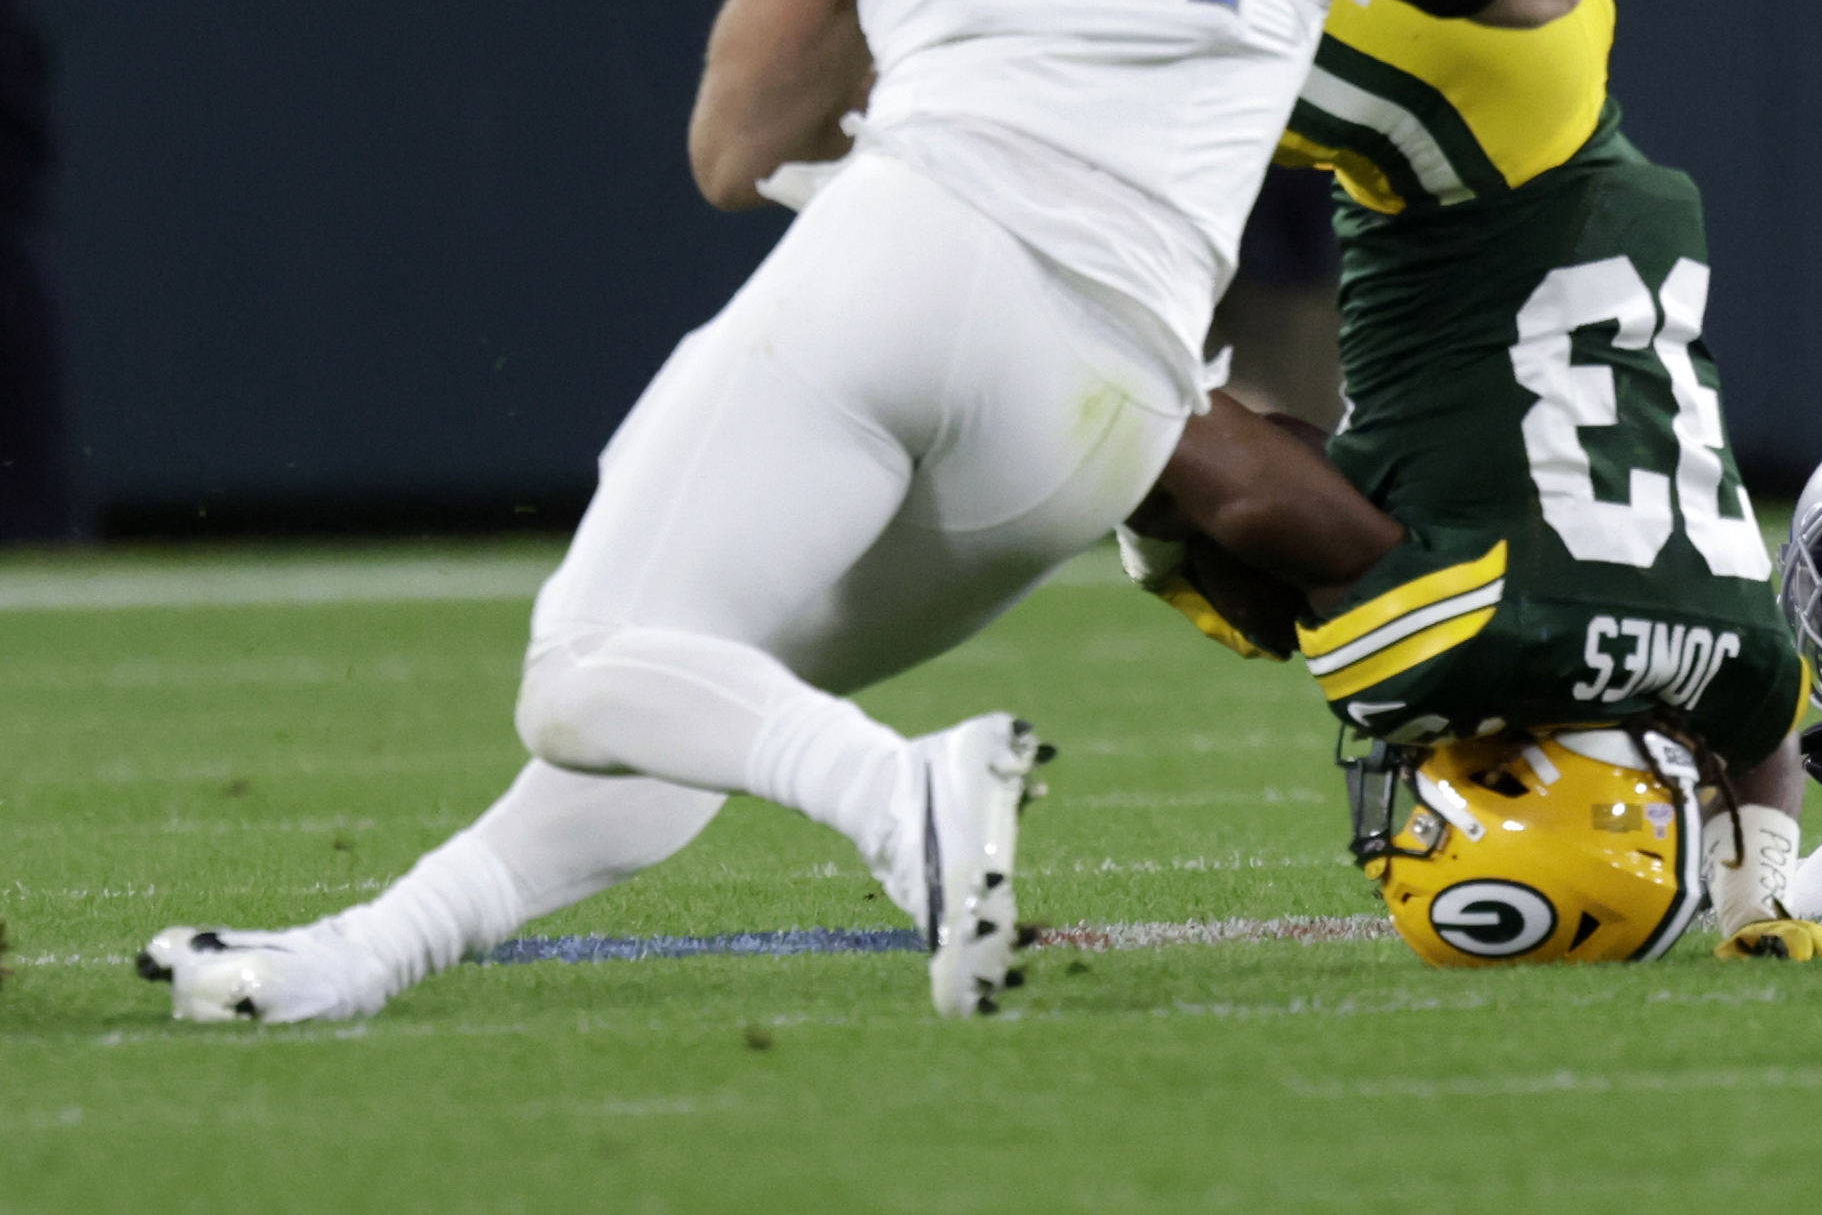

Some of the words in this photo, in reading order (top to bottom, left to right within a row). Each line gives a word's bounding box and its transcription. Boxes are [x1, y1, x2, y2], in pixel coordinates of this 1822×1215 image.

[1509, 254, 1773, 582] 33
[1573, 614, 1741, 711] JONES
[1429, 878, 1559, 959] G
